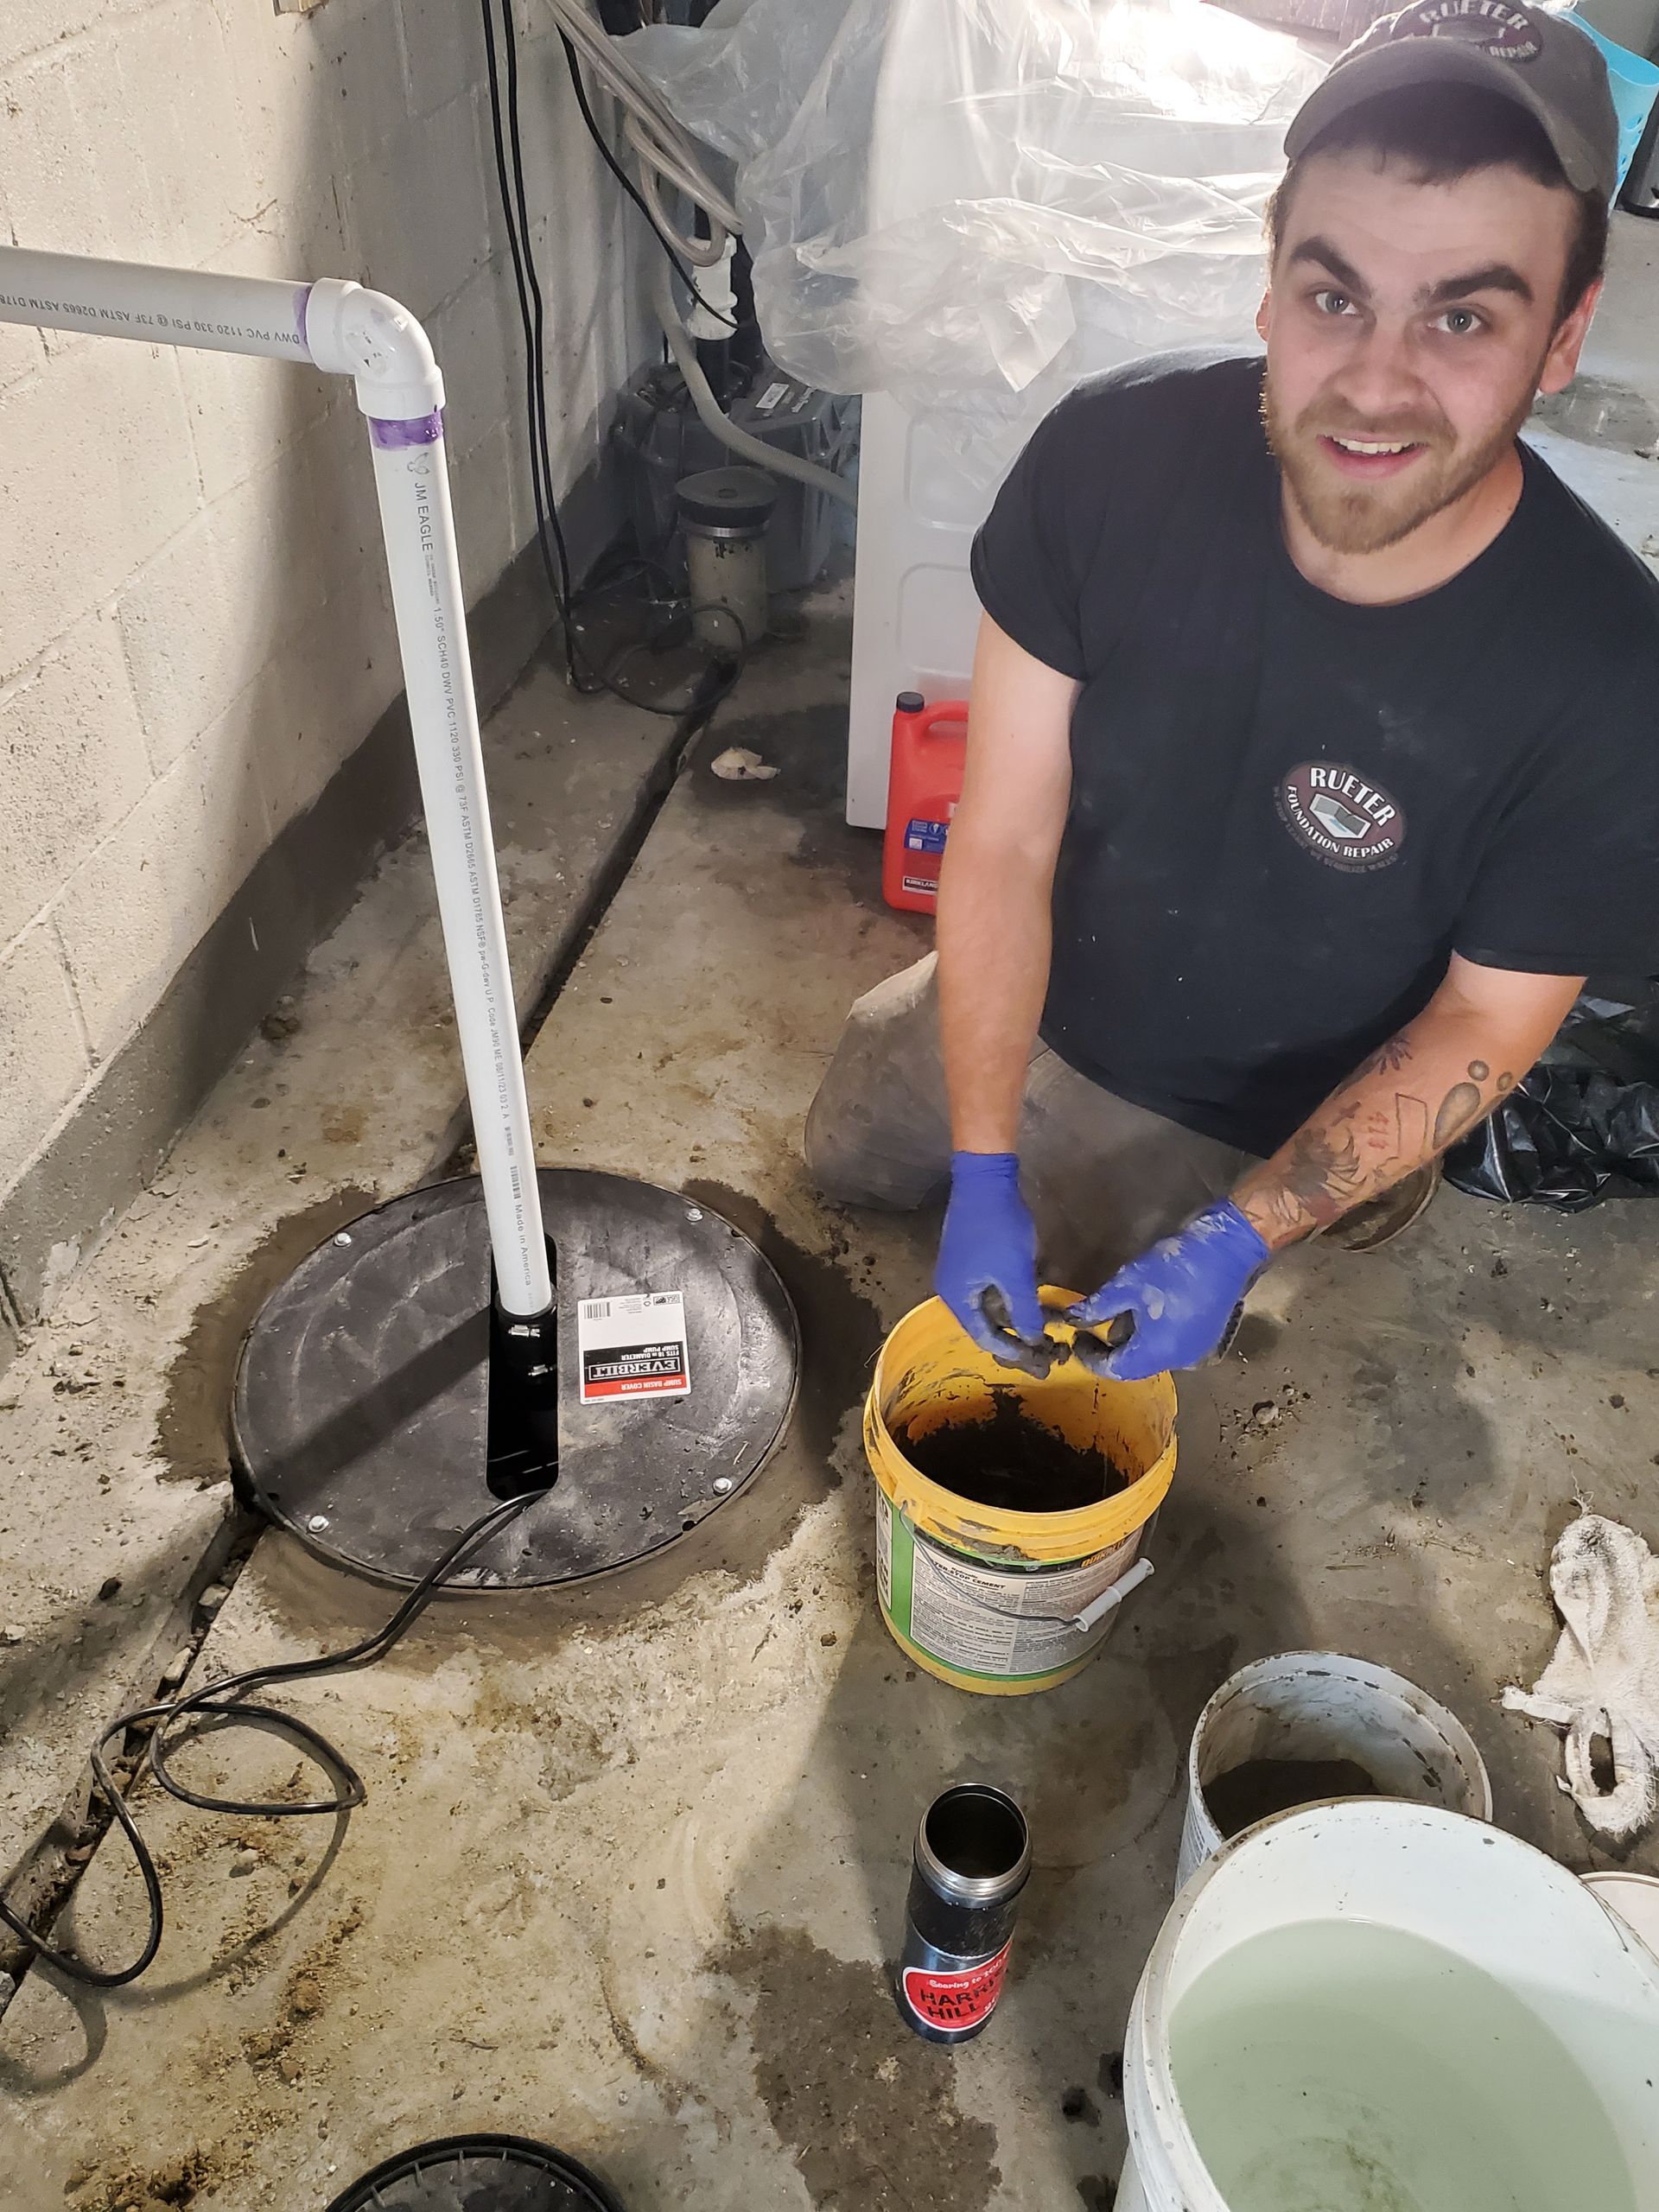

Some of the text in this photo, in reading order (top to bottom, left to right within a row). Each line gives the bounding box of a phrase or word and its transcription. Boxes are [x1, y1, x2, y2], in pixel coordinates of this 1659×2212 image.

[29, 299, 59, 312] ASTM
[62, 302, 96, 318] D2665
[99, 307, 130, 322] ASTM
[136, 312, 154, 326] 73F
[173, 317, 192, 331] PSI
[195, 320, 214, 334] 330
[219, 322, 242, 337] 1120
[248, 327, 270, 341] PVC
[274, 330, 300, 346] DWV
[413, 480, 427, 501] JM
[416, 505, 434, 551] EAGLE
[436, 635, 448, 669] SCH40
[442, 671, 452, 695] DWV
[445, 697, 455, 718] PVC
[448, 721, 459, 744] 1120
[452, 745, 461, 762] 330
[454, 765, 463, 782] PSI
[459, 795, 467, 812] 73F
[1310, 767, 1396, 827] RUETER
[461, 814, 471, 840] ASTM
[1287, 785, 1395, 858] FOUNDATION REPAIR
[468, 870, 479, 895] ASTM
[487, 1007, 497, 1027] Code
[515, 1203, 524, 1231] Made
[519, 1235, 526, 1243] in
[520, 1245, 532, 1286] America
[621, 1351, 652, 1361] DIAMETER
[594, 1359, 677, 1377] EVERBILT
[621, 1382, 644, 1391] COVER
[664, 1378, 682, 1388] SUMP
[933, 1560, 1007, 1589] TER-STOP CEMENT
[929, 1979, 969, 1990] Soaring
[972, 1975, 982, 1985] to
[927, 2002, 979, 2019] HILL
